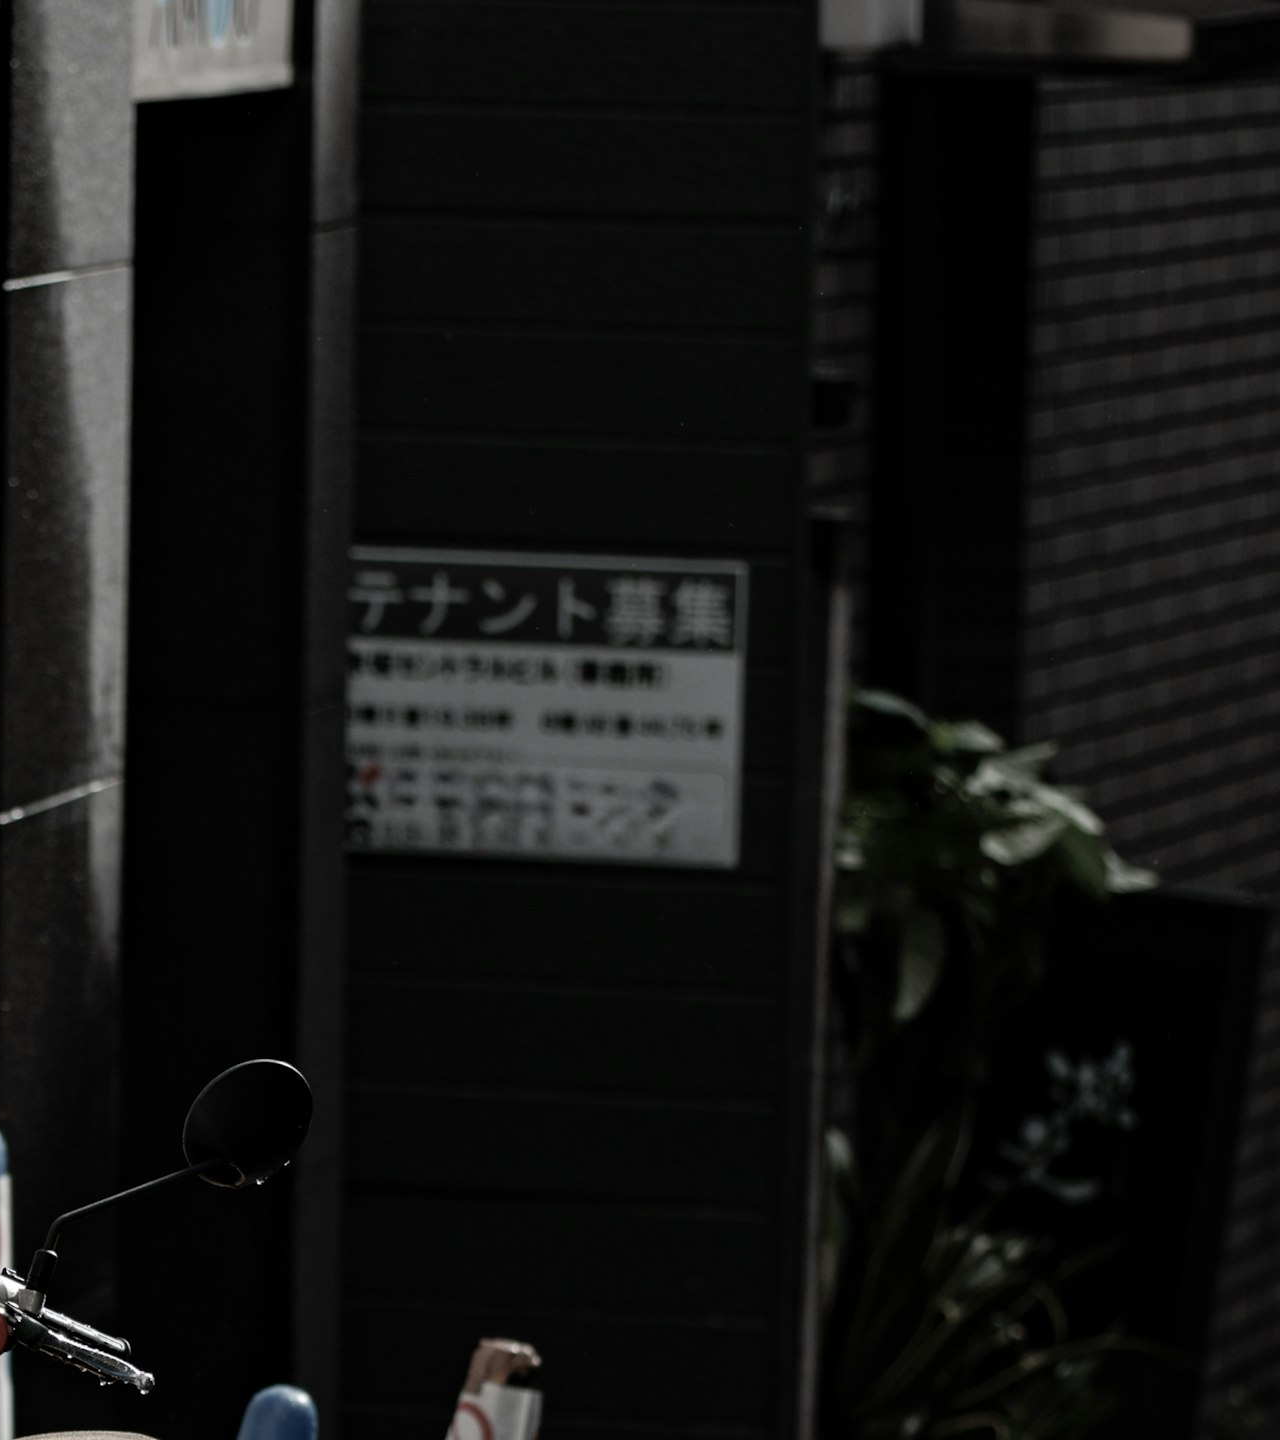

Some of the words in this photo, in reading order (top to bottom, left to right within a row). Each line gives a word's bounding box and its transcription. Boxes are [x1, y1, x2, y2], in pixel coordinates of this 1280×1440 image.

[347, 570, 733, 648] テナント募集
